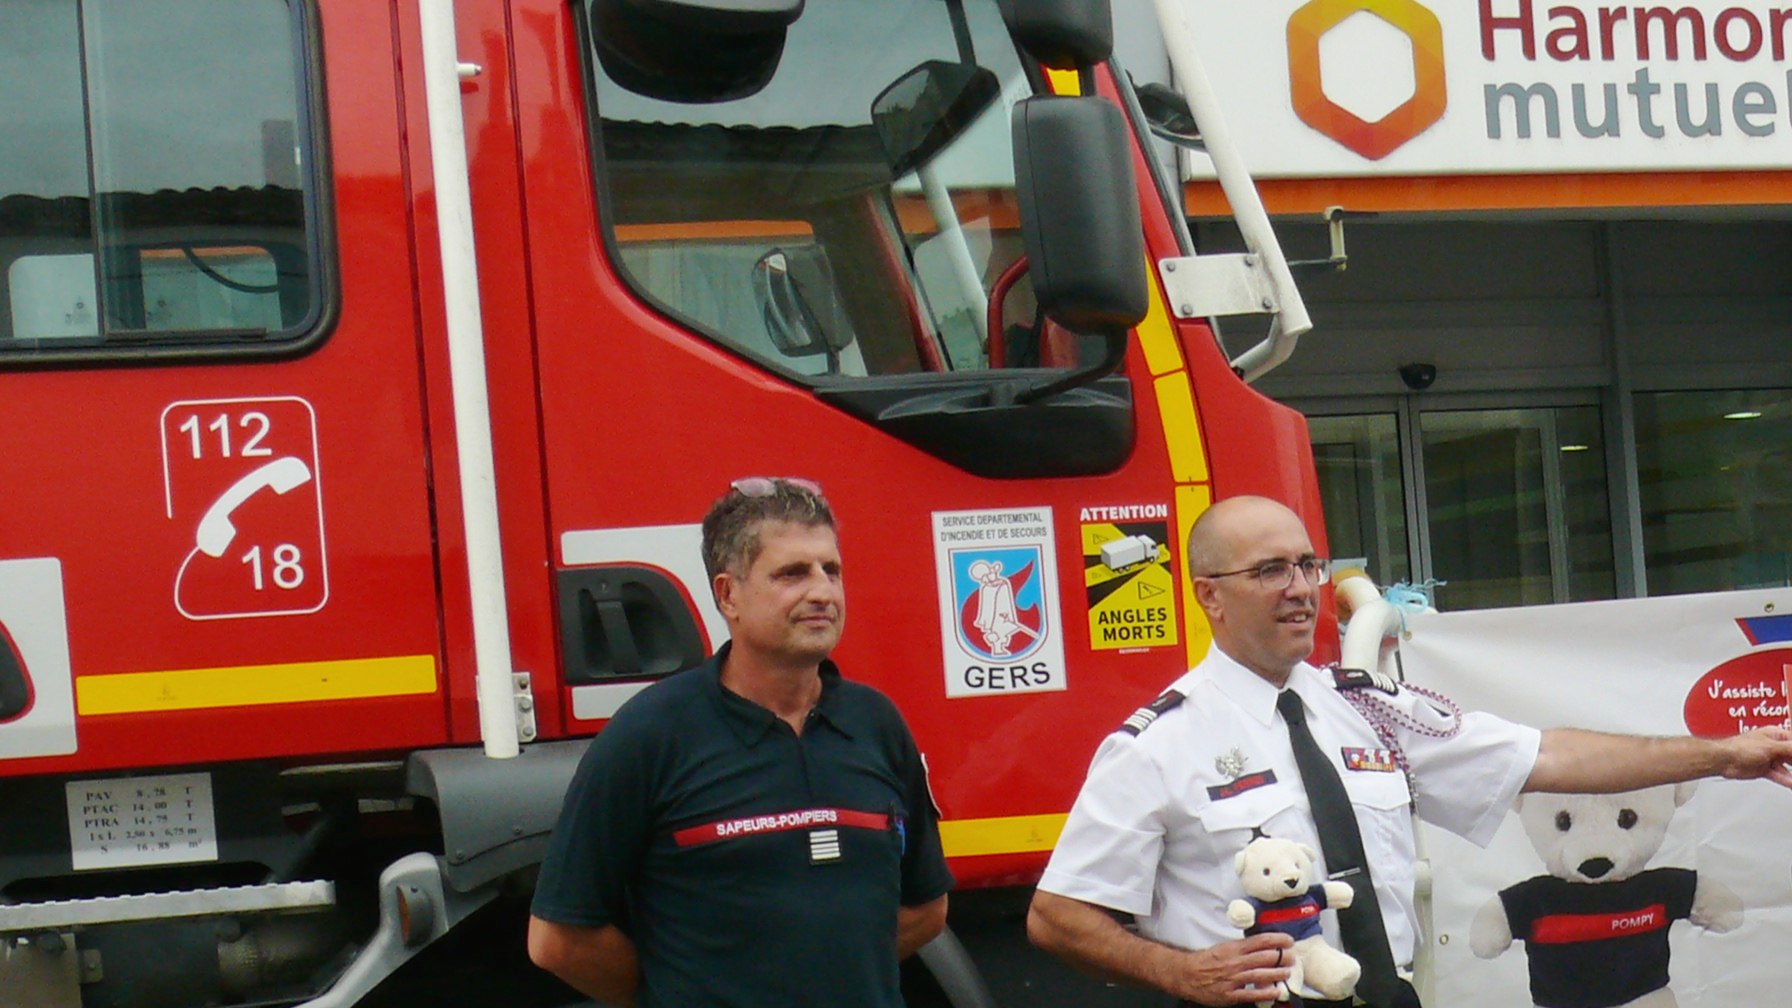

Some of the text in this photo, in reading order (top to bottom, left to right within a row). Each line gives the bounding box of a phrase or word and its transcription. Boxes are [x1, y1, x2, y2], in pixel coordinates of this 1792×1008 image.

[180, 412, 273, 459] 112
[942, 512, 1043, 527] SERVICE DEPARTEMENTAL
[1079, 503, 1168, 522] ATTENTION
[940, 526, 1047, 542] D'INCENDIE ET DE SECOURS
[242, 544, 304, 590] 18
[1098, 607, 1168, 625] ANGLES
[1102, 625, 1166, 642] MORTS
[964, 661, 1051, 690] GERS
[1708, 679, 1776, 699] J'assiste
[1728, 705, 1747, 718] en
[86, 791, 112, 801] PAV
[83, 804, 118, 815] PTAC
[84, 817, 119, 829] PTRA
[716, 810, 838, 836] SAPEURS-POMPIERS
[1611, 913, 1655, 930] POMPY
